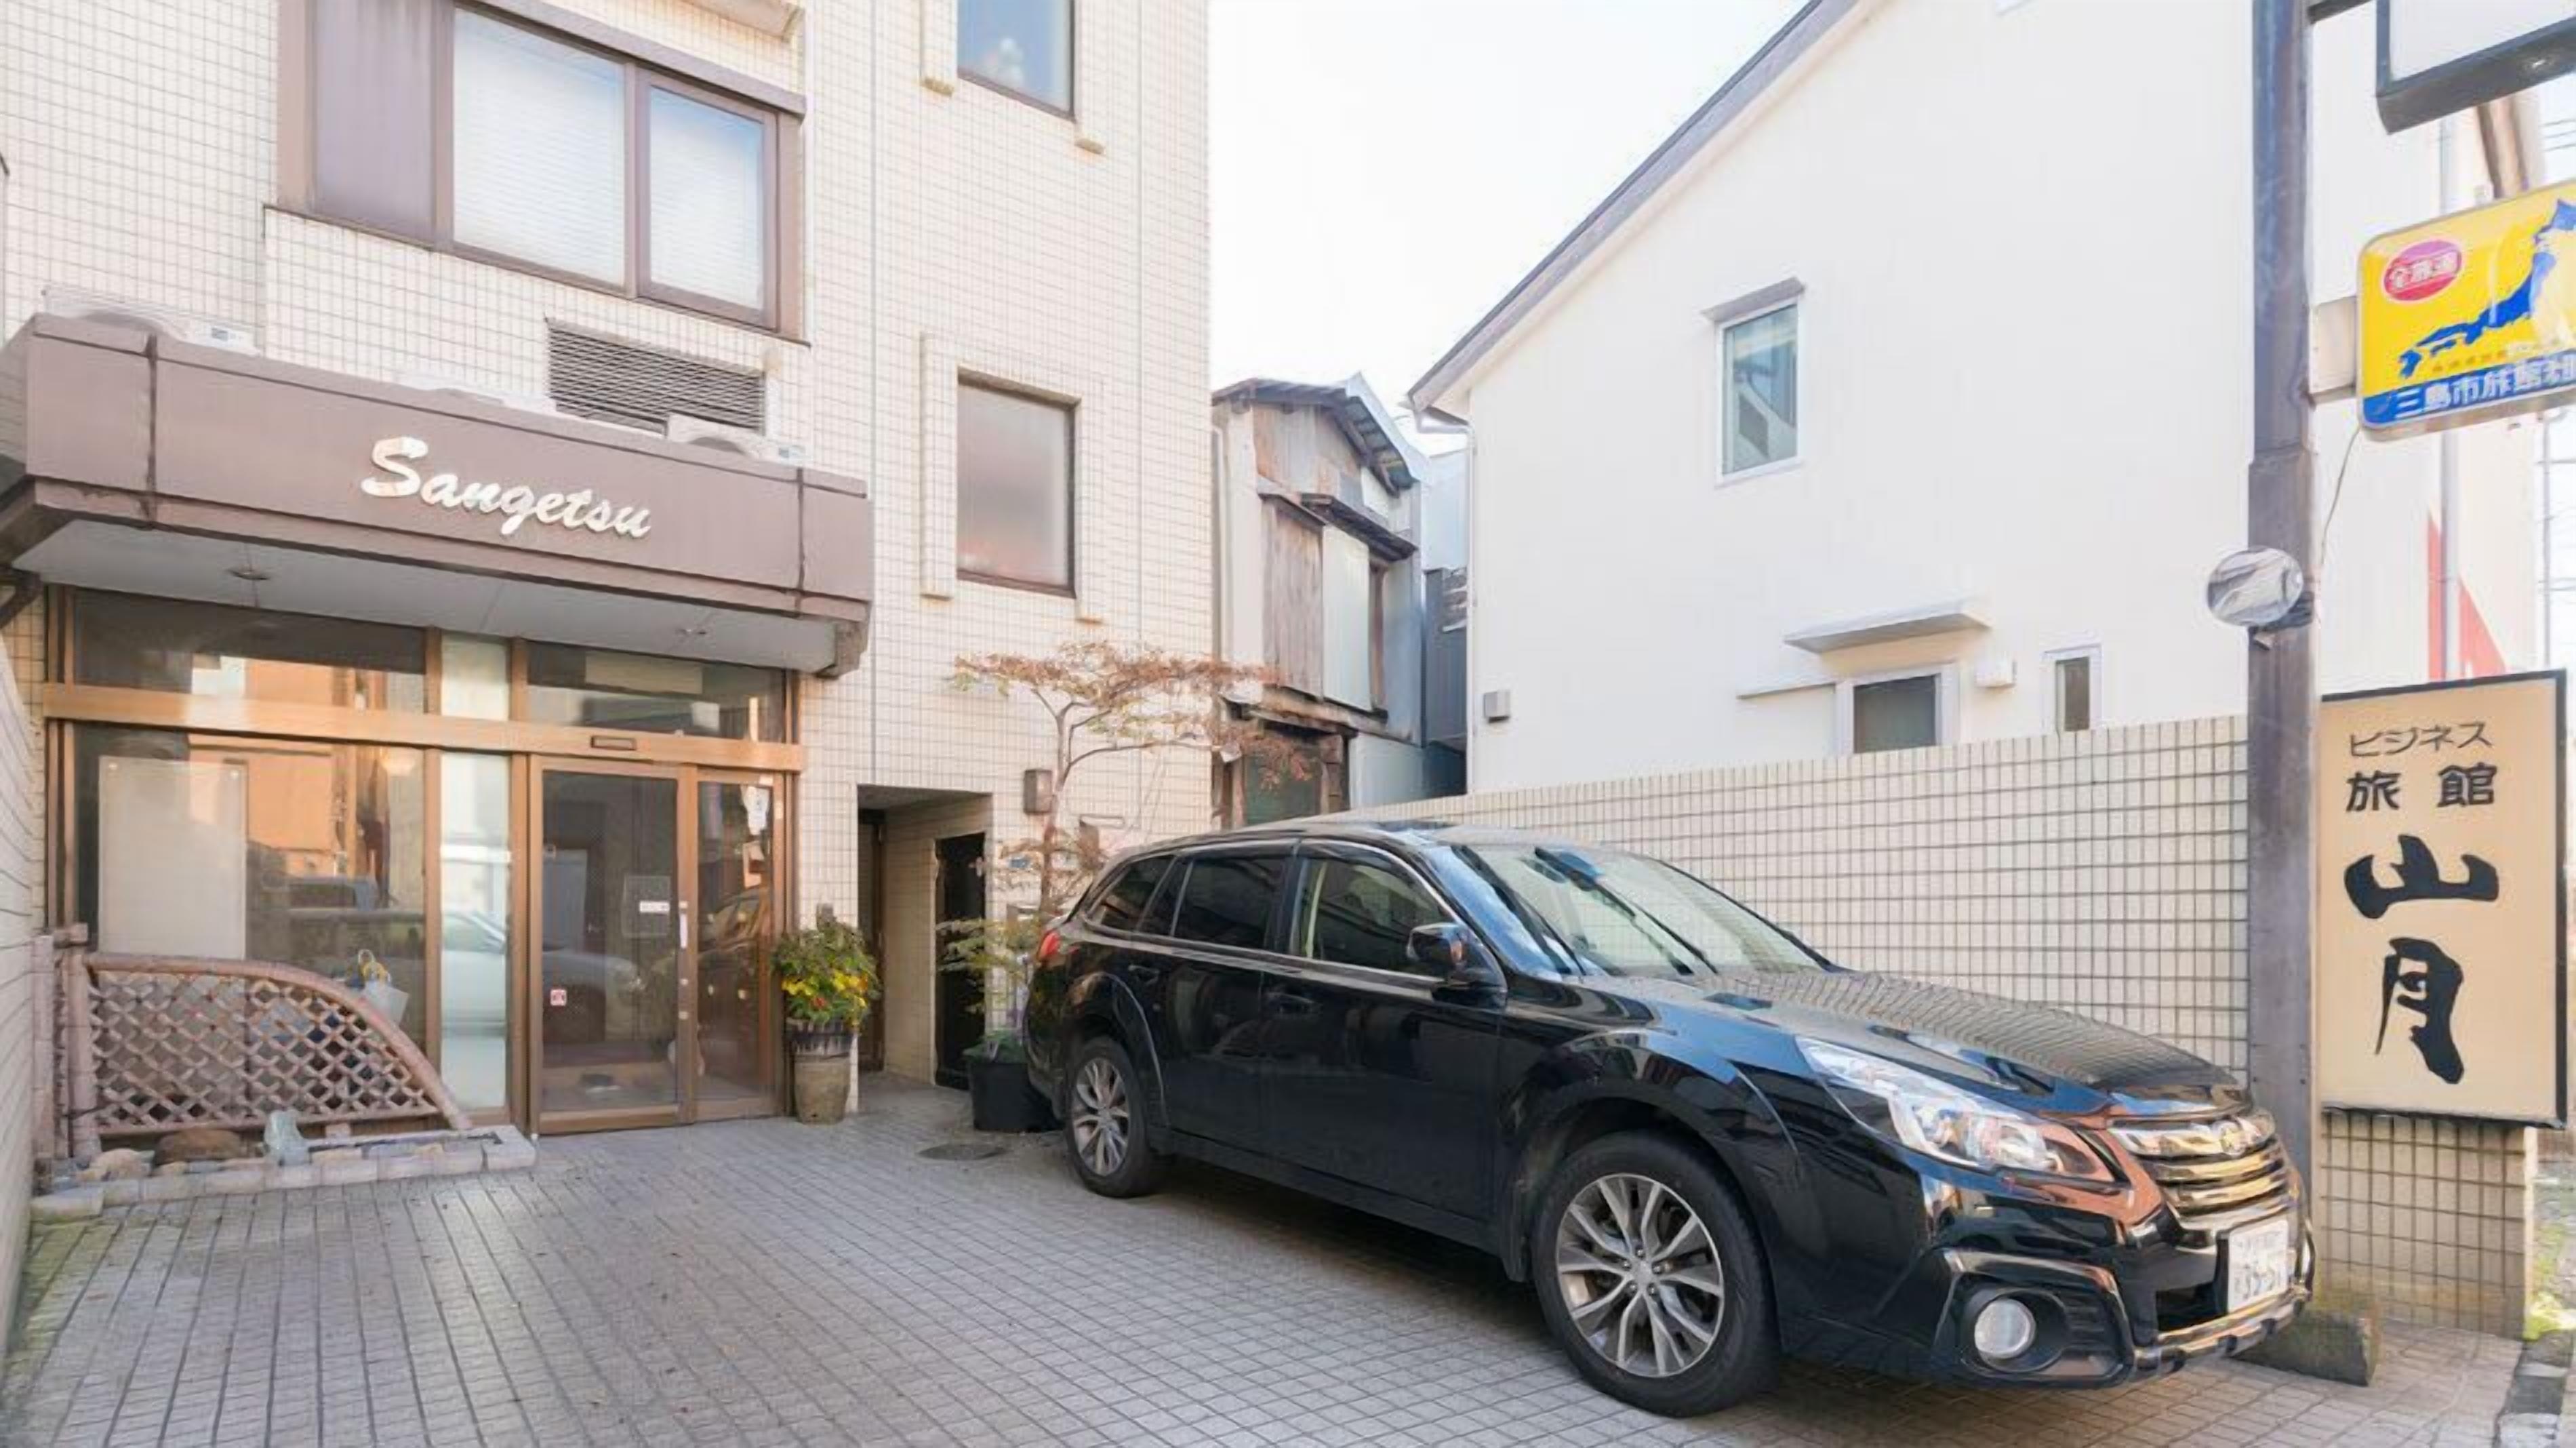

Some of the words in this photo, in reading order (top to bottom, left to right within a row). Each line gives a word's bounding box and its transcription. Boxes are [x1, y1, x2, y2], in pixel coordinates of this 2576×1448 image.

[361, 436, 651, 538] Sangetsu
[2350, 721, 2495, 757] ビジネス
[2346, 761, 2498, 813] 旅館
[2343, 833, 2500, 1085] 山月
